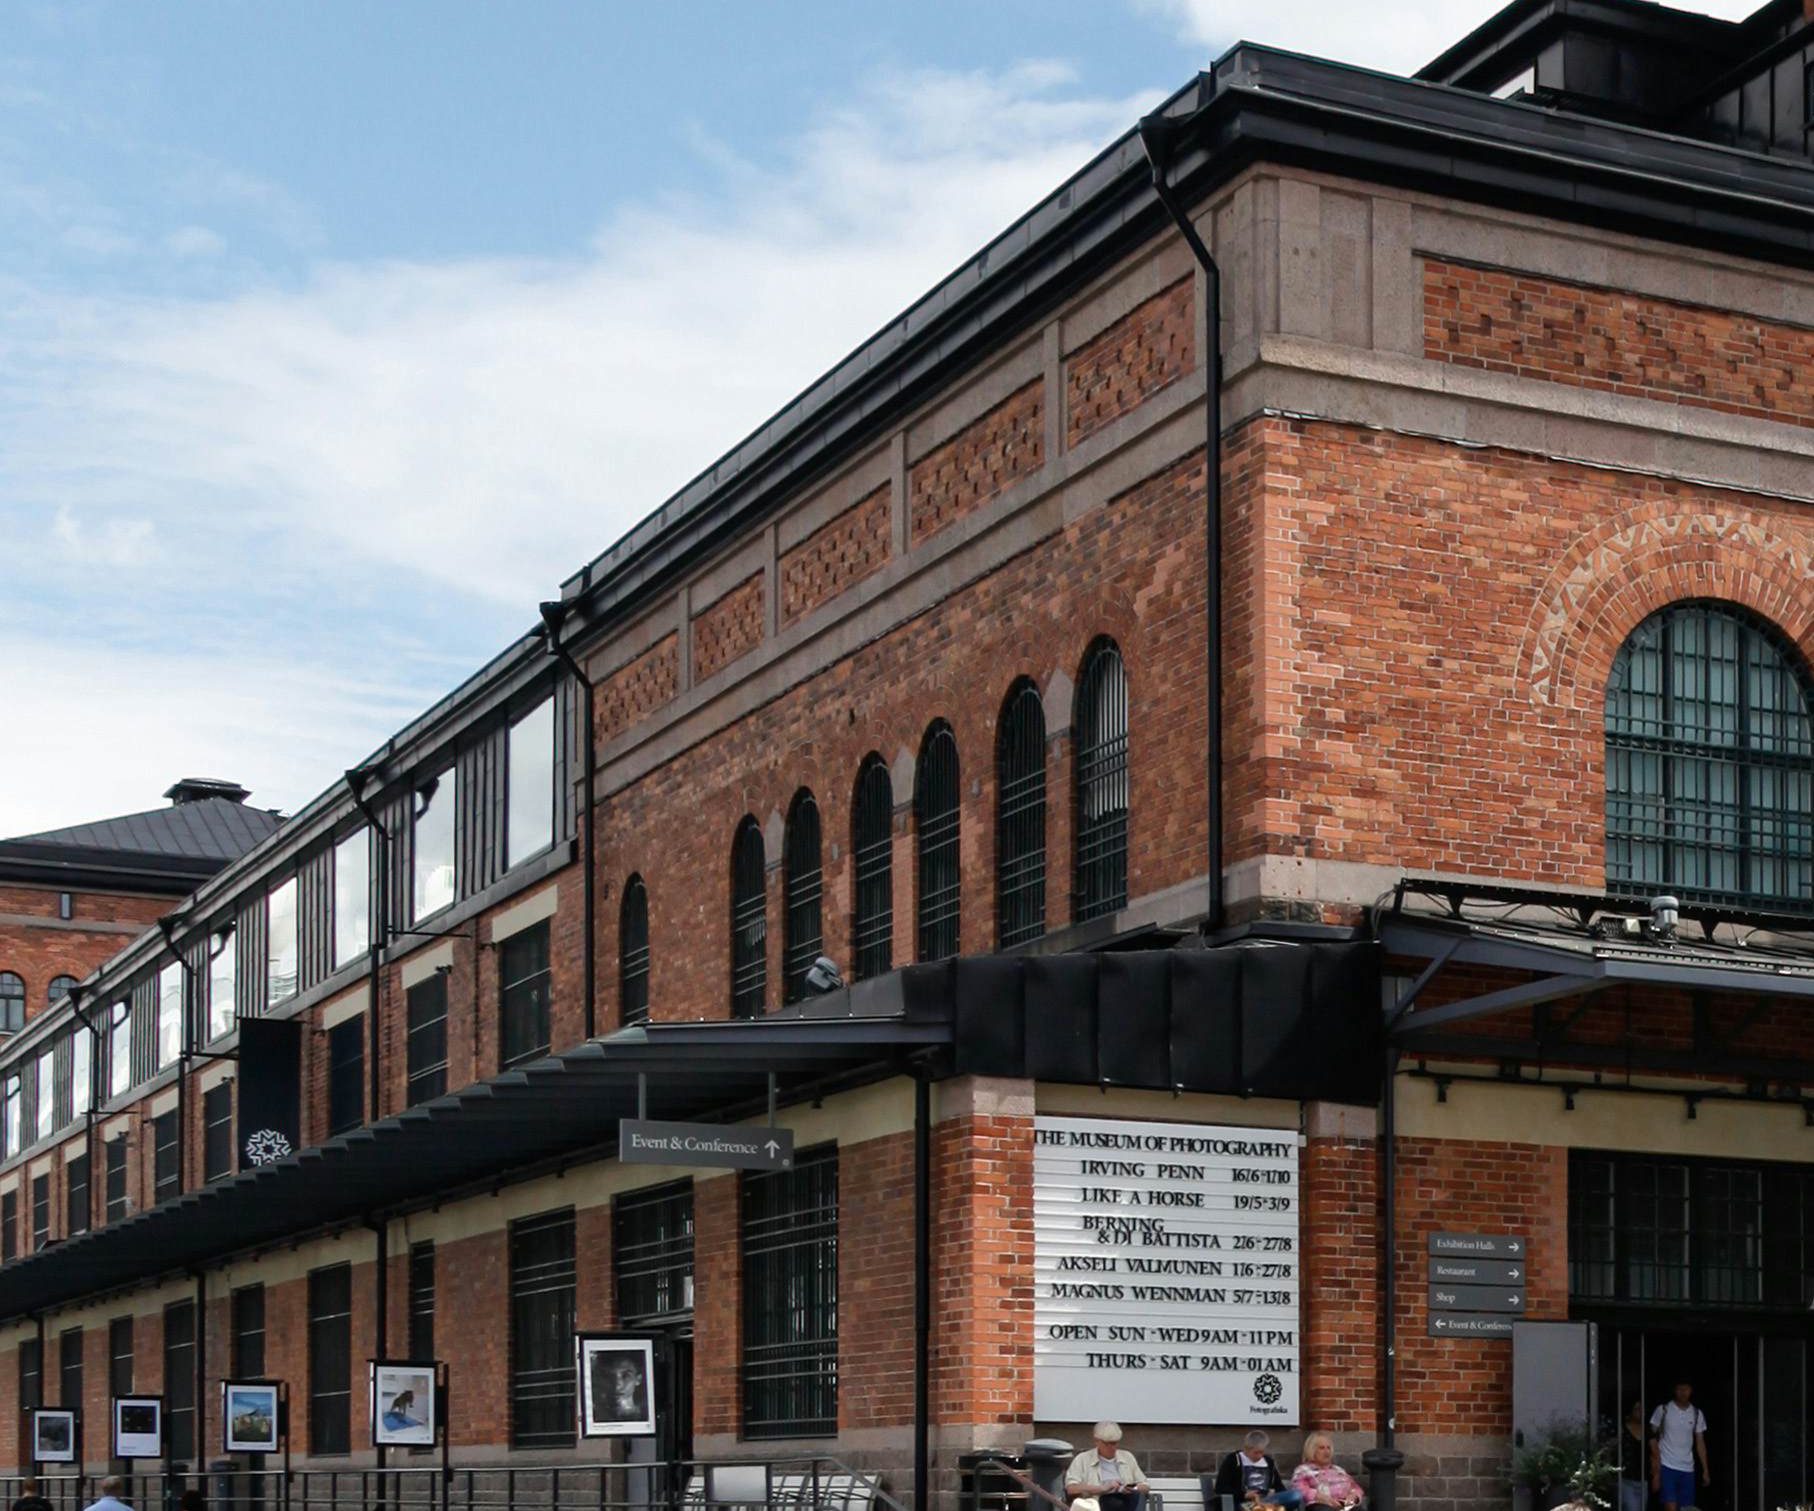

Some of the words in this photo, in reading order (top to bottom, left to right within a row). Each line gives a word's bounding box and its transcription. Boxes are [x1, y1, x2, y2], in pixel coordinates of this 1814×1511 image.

[631, 1133, 668, 1149] Event
[670, 1135, 683, 1150] &
[684, 1136, 759, 1155] Conference
[1033, 1130, 1065, 1145] THE
[1070, 1132, 1141, 1150] MUSEUM
[1145, 1136, 1168, 1151] OF
[1170, 1138, 1292, 1158] PHOTOGRAPHY
[1081, 1160, 1145, 1177] IRVING
[1157, 1164, 1205, 1180] PENN
[1130, 1190, 1141, 1205] A
[1148, 1191, 1205, 1207] HORSE
[1082, 1216, 1164, 1233] BERNING
[1142, 1232, 1221, 1249] BATTISTA
[1436, 1238, 1475, 1250] Exhibition
[1057, 1256, 1117, 1272] AKSELI
[1127, 1258, 1222, 1276] VALMUNEN
[1436, 1265, 1477, 1276] Restaurant
[1051, 1283, 1124, 1300] MAGNUS
[1132, 1286, 1226, 1304] WENNMAN
[1436, 1291, 1457, 1305] Shop
[1448, 1319, 1469, 1329] Event
[1050, 1324, 1098, 1340] OPEN
[1108, 1326, 1146, 1342] SUN
[1086, 1352, 1147, 1369] THURS
[1159, 1355, 1192, 1370] SAT
